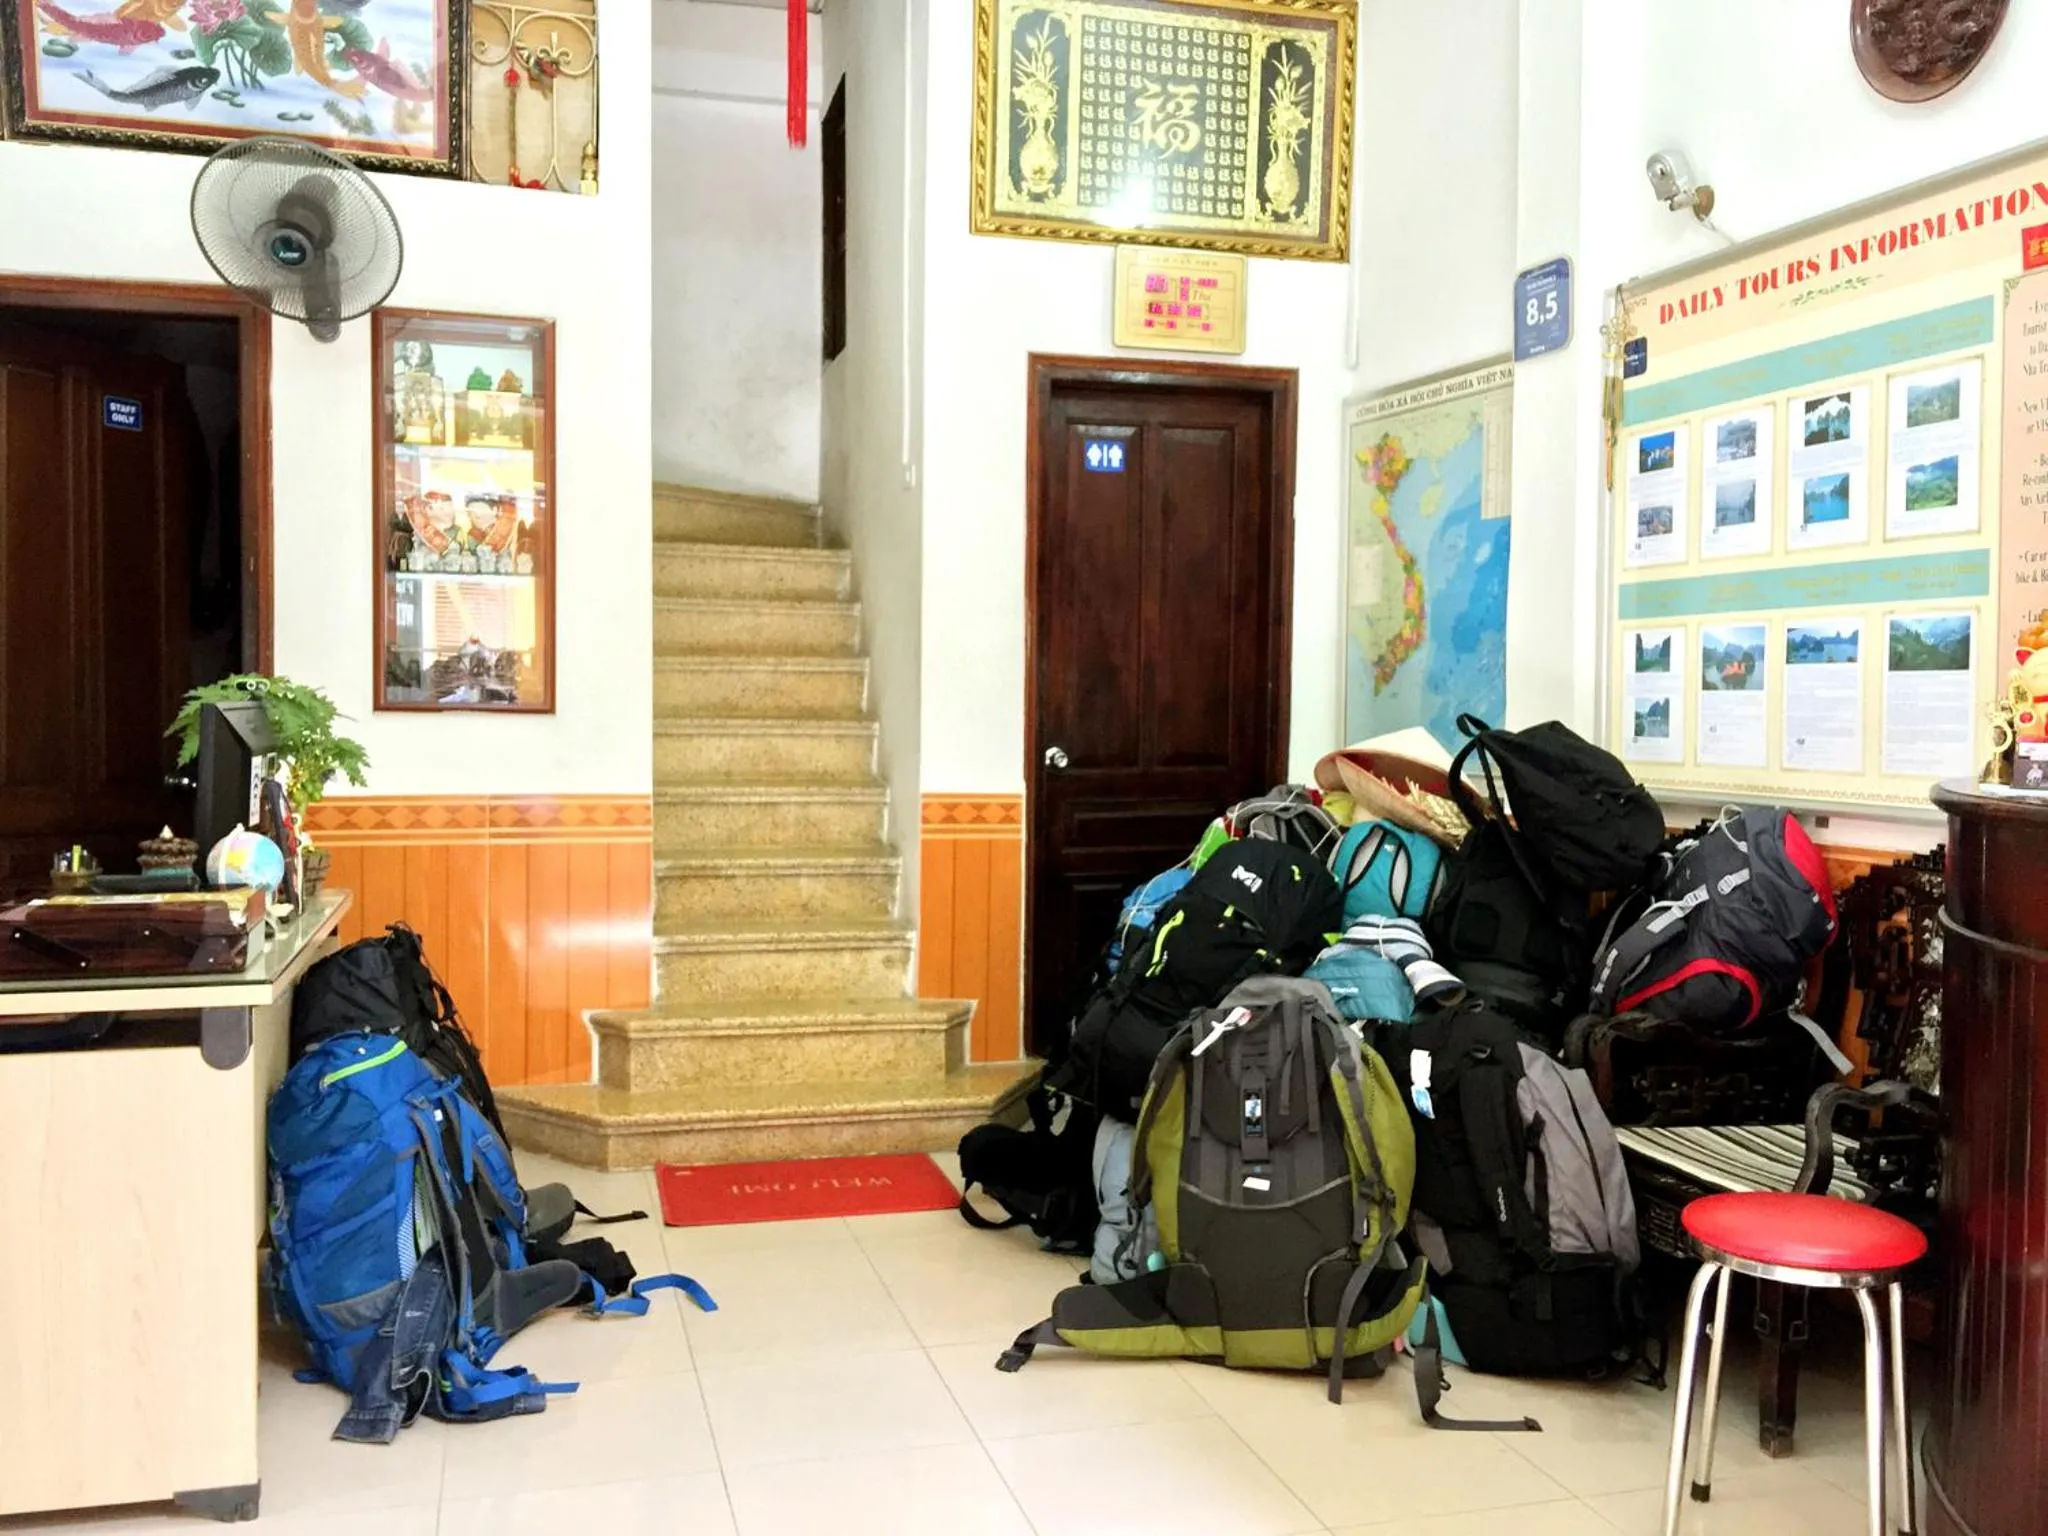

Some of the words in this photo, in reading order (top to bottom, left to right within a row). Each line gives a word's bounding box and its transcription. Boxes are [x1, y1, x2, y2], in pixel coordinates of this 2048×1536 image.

[1660, 283, 1728, 325] DAILY
[1733, 255, 1820, 300] TOURS
[1526, 290, 1558, 326] 8,5
[109, 402, 136, 414] STAFF
[111, 412, 135, 424] ONLY
